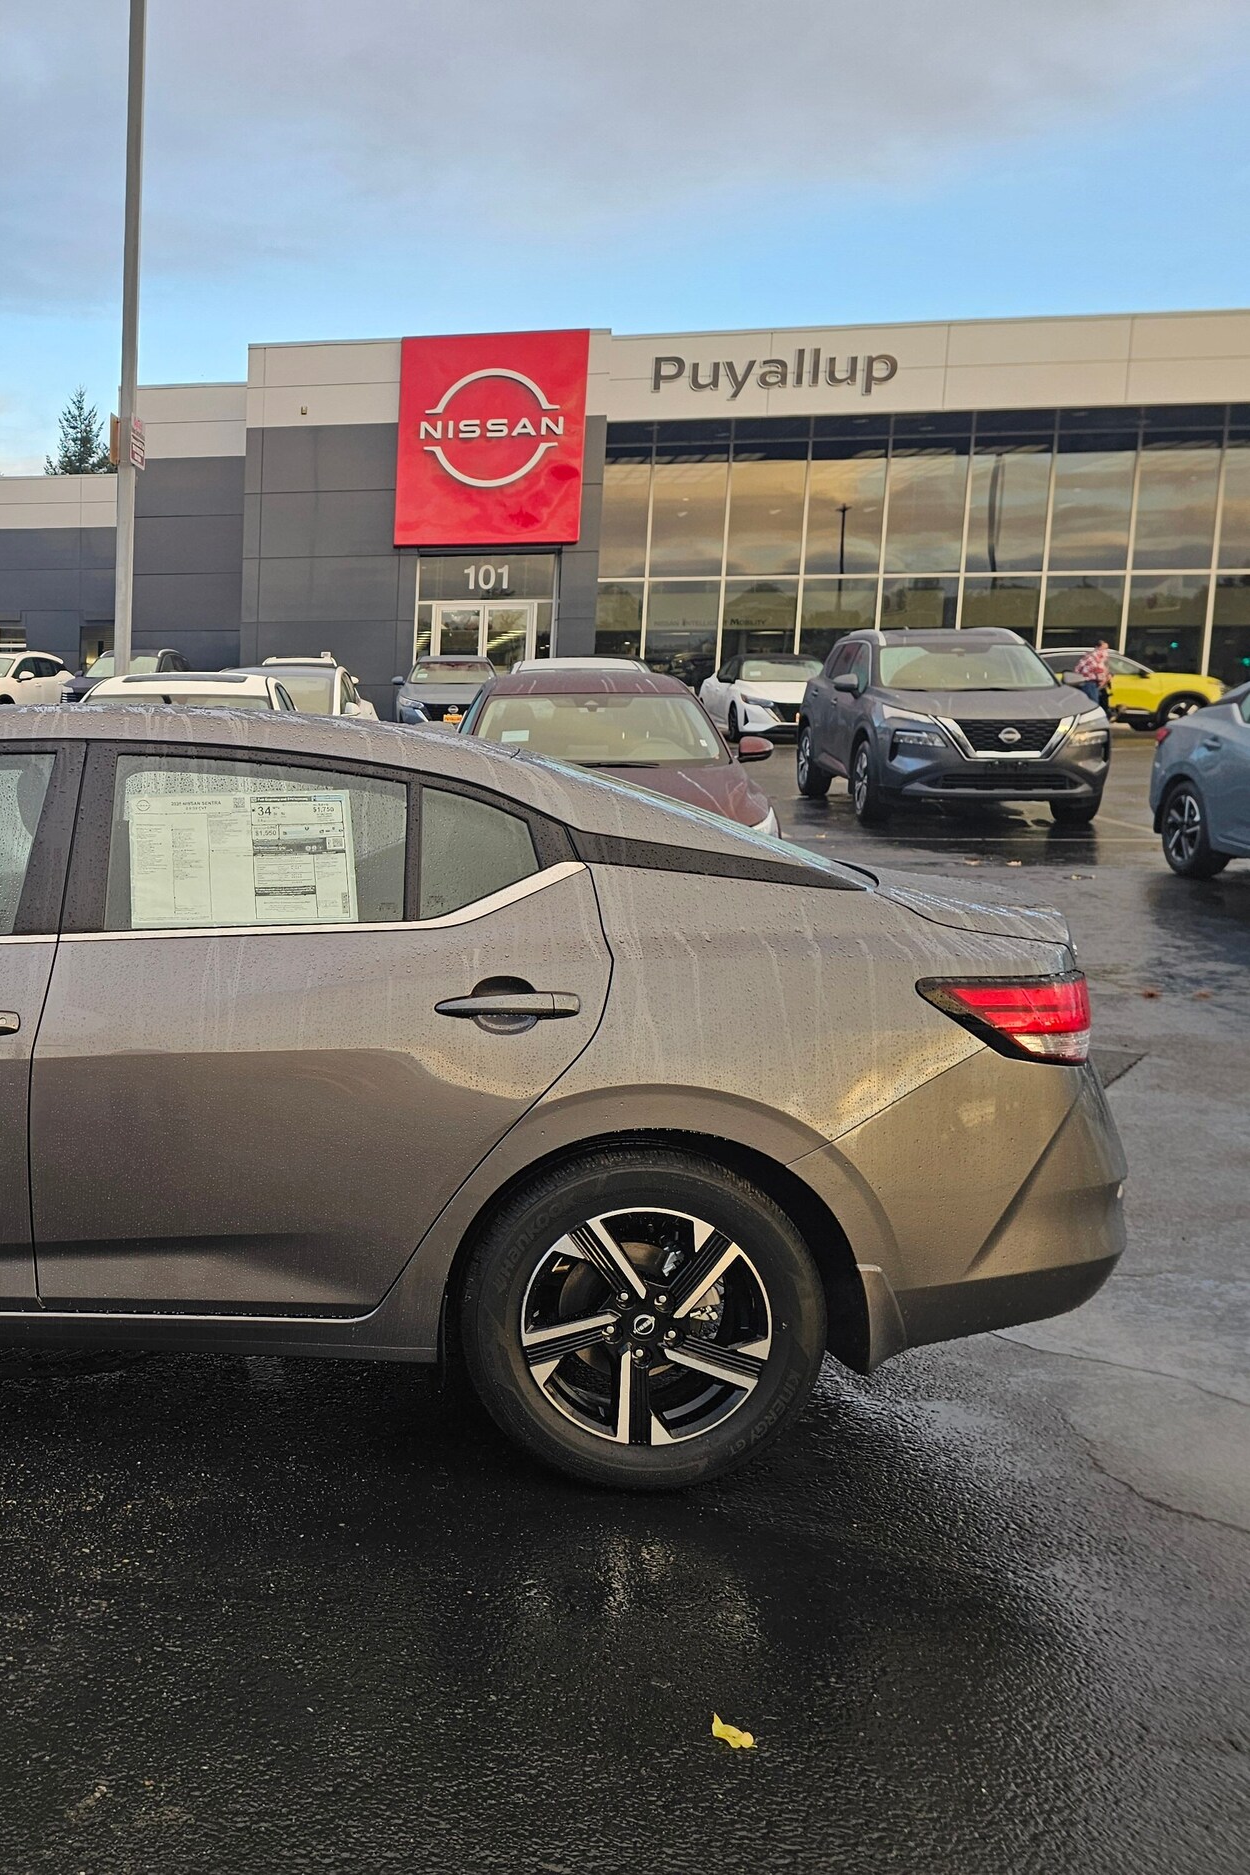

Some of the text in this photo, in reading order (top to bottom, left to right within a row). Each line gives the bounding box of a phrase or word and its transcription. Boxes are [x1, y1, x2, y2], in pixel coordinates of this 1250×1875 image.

[650, 347, 899, 401] Puyallup
[419, 416, 565, 440] NISSAN
[464, 564, 510, 590] 101
[257, 806, 272, 816] 34
